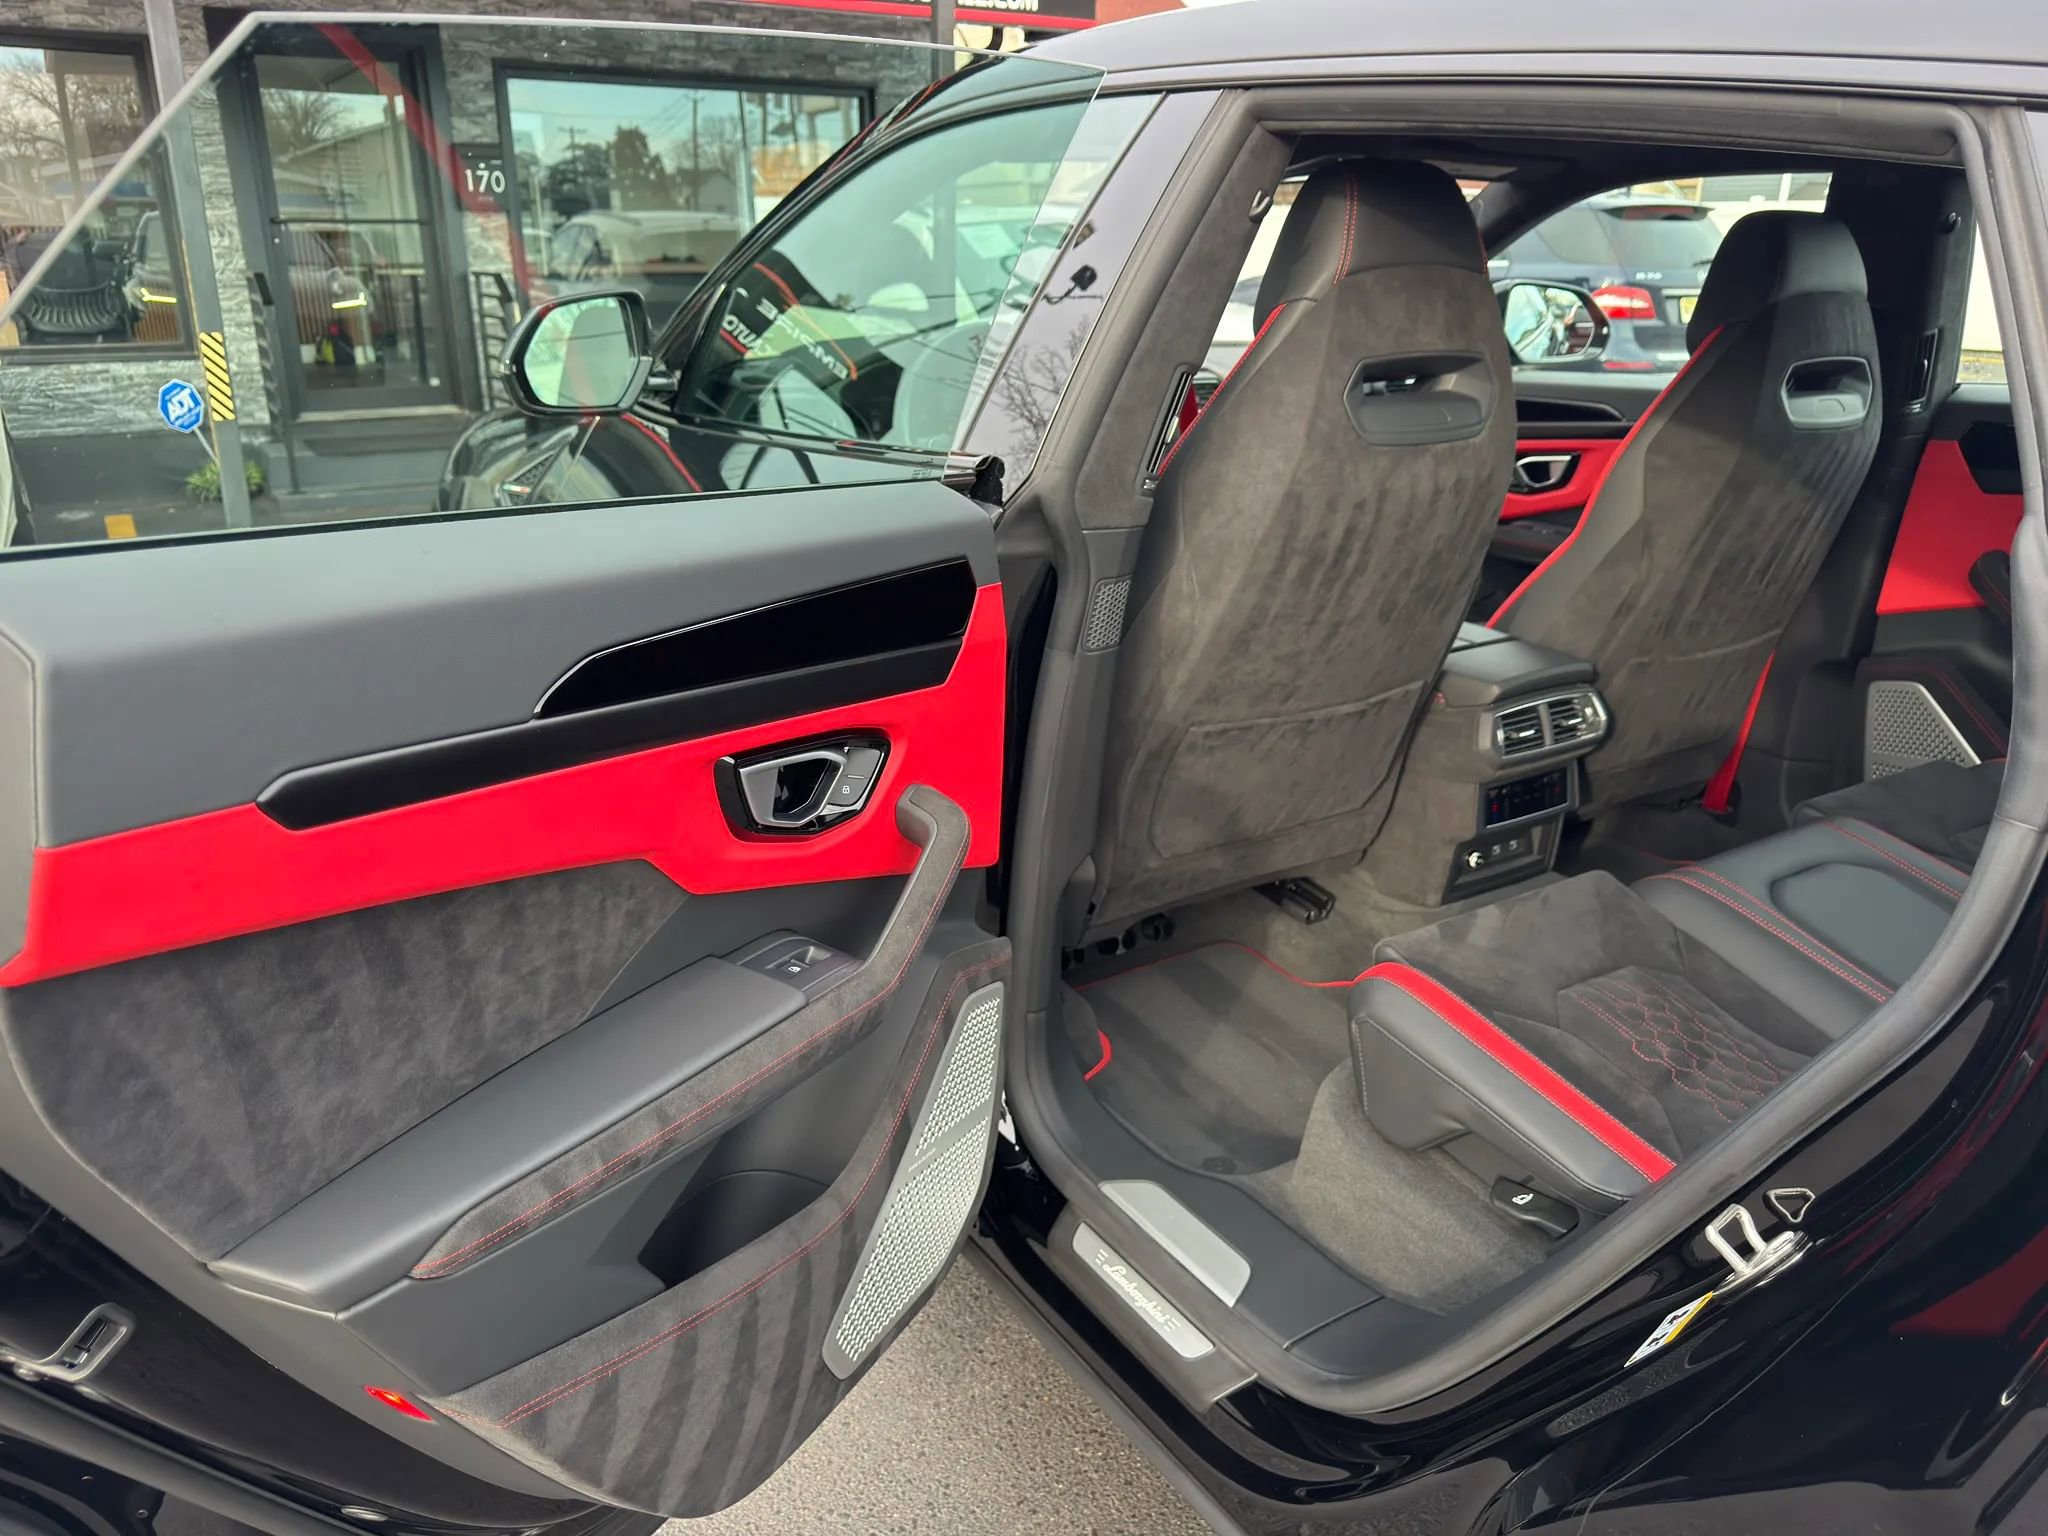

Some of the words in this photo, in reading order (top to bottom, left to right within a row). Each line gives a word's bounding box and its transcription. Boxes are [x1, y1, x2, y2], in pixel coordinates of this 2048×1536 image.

[464, 168, 506, 194] 170
[167, 387, 196, 423] ADT
[1102, 1264, 1170, 1323] Lamborghini
